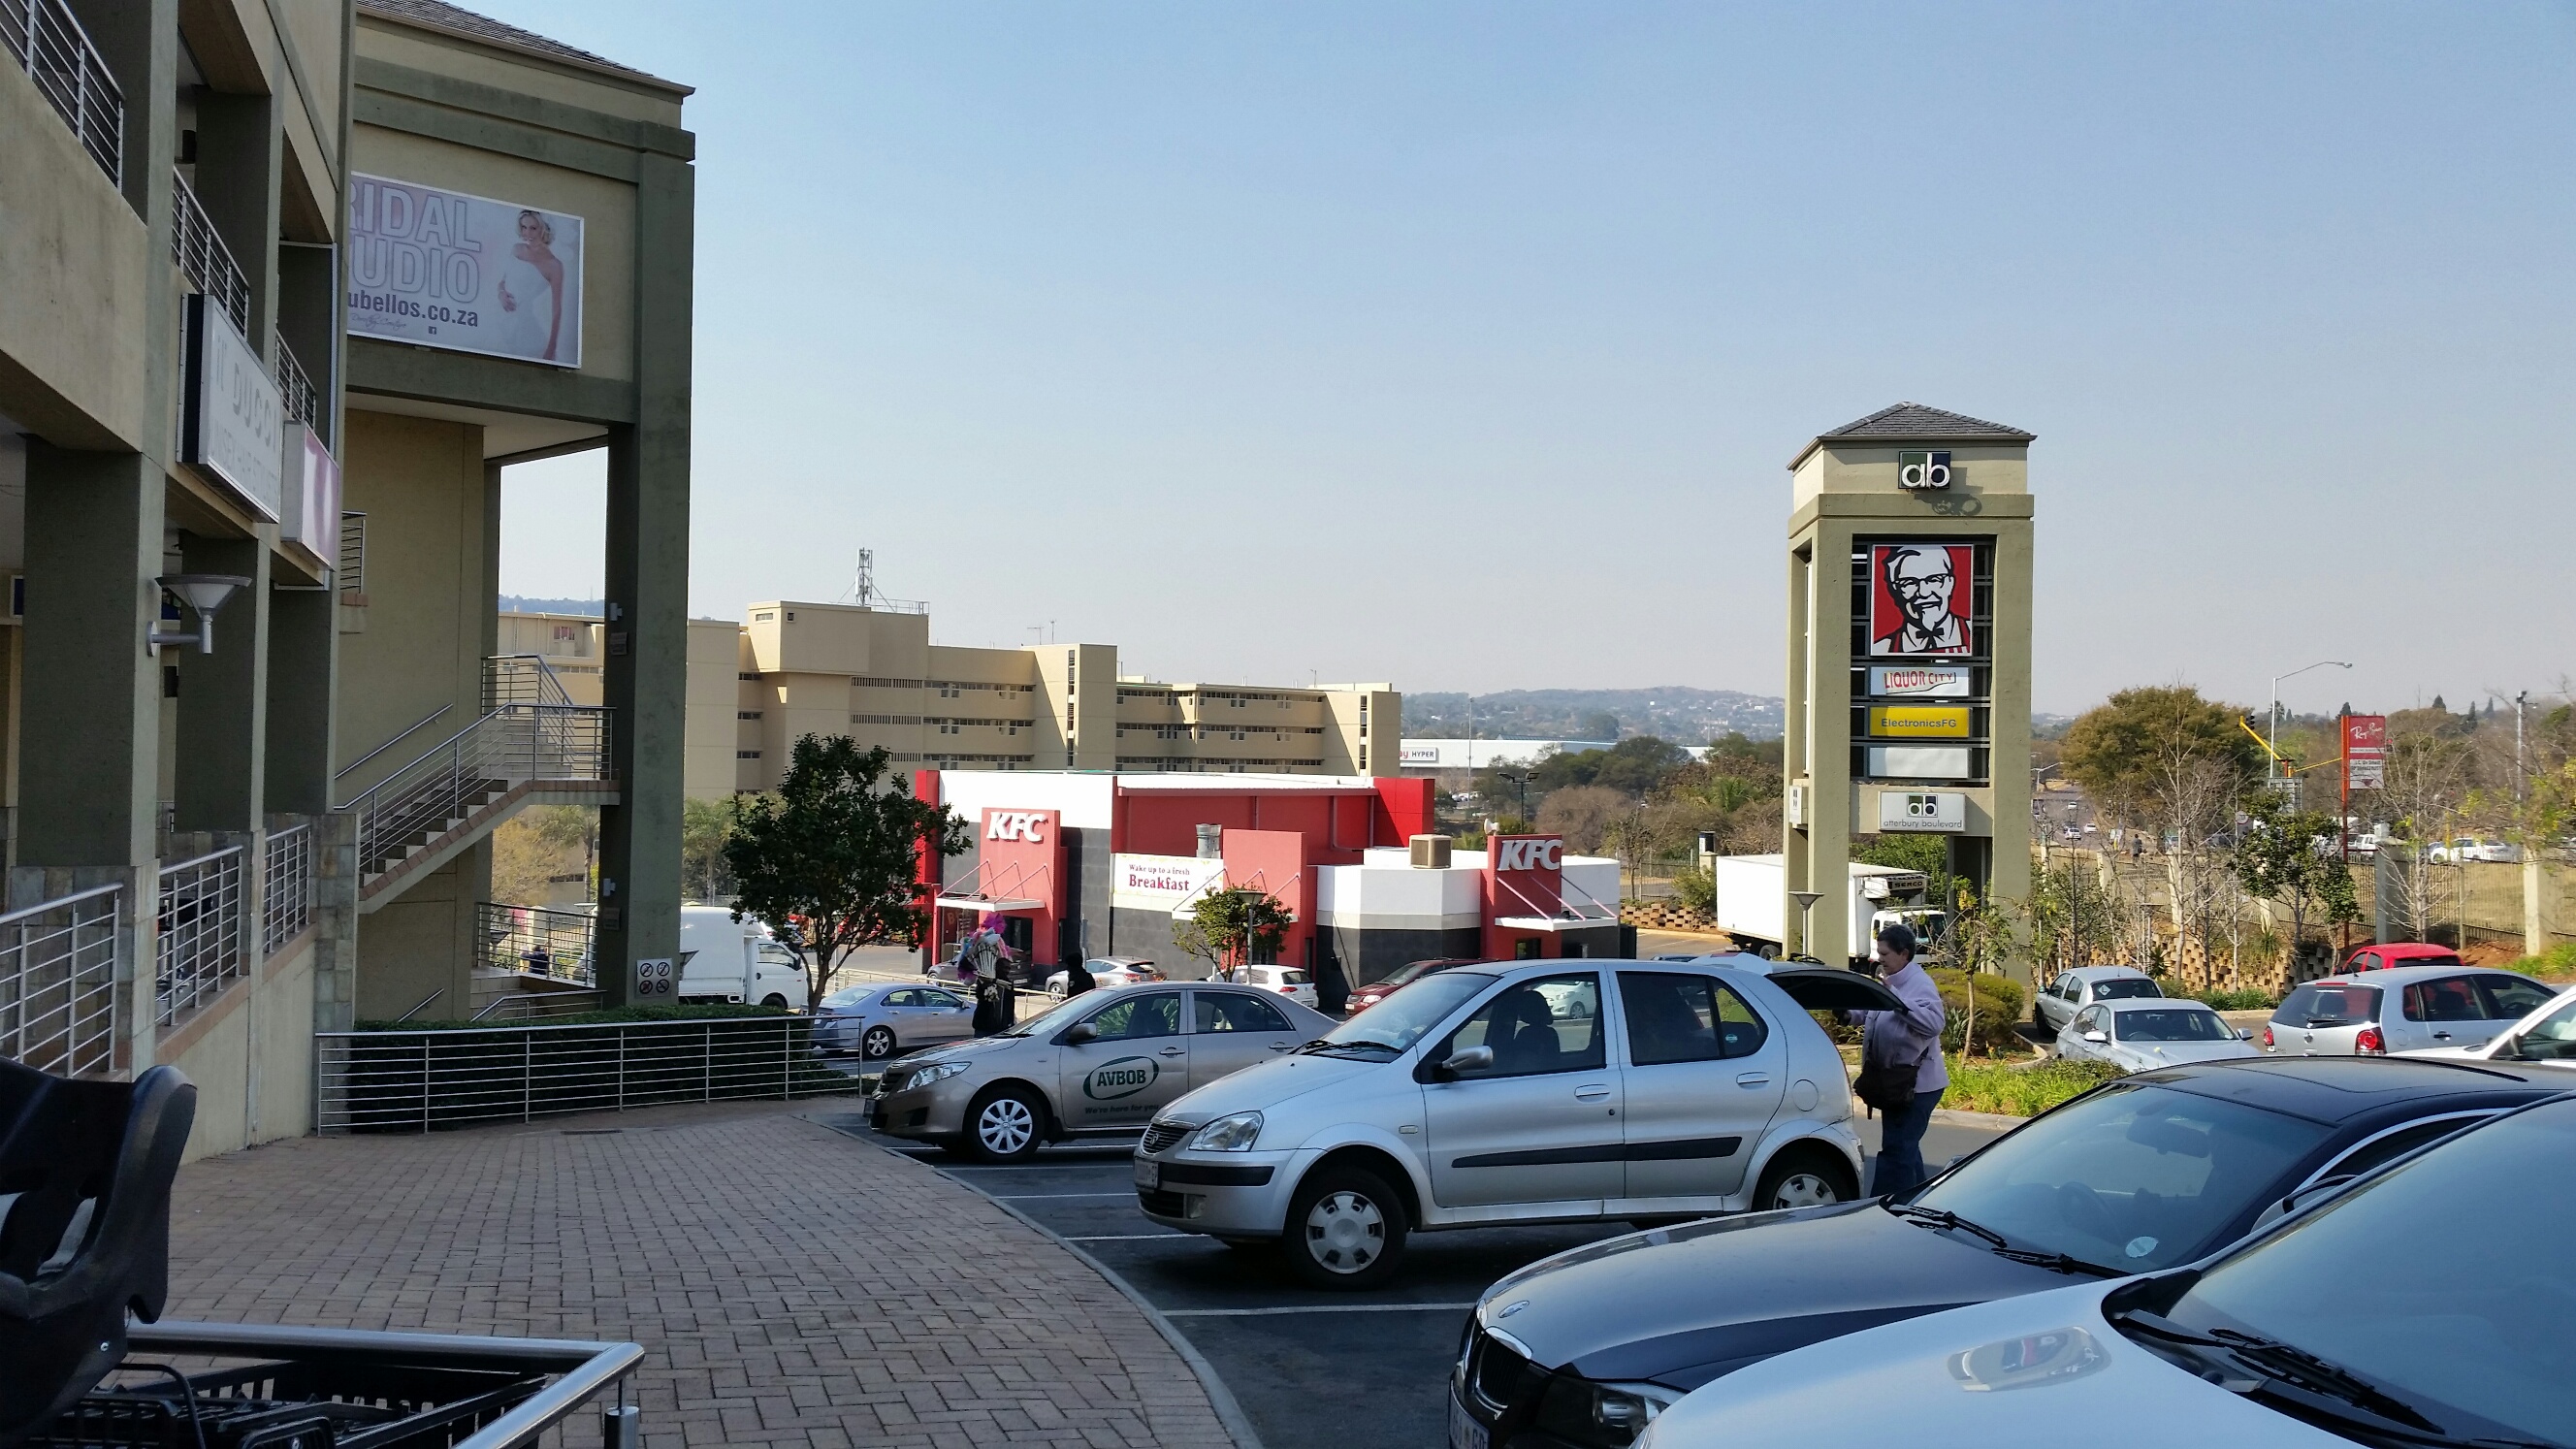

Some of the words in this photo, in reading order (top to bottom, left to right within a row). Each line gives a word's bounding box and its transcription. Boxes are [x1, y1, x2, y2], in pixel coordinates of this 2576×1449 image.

[1884, 670, 1926, 689] LIQUOR
[1928, 672, 1953, 685] CITY
[1881, 718, 1957, 728] ElectronicsFG
[986, 811, 1047, 842] KFC
[1883, 819, 1919, 828] atterbury
[1921, 819, 1963, 828] boulevard
[1497, 839, 1563, 871] KFC
[1128, 863, 1147, 873] Wake
[1148, 866, 1157, 875] up
[1172, 866, 1191, 876] fresh
[1128, 873, 1190, 891] Breakfast
[1096, 1069, 1146, 1087] AVBOB
[1084, 1106, 1109, 1114] We're
